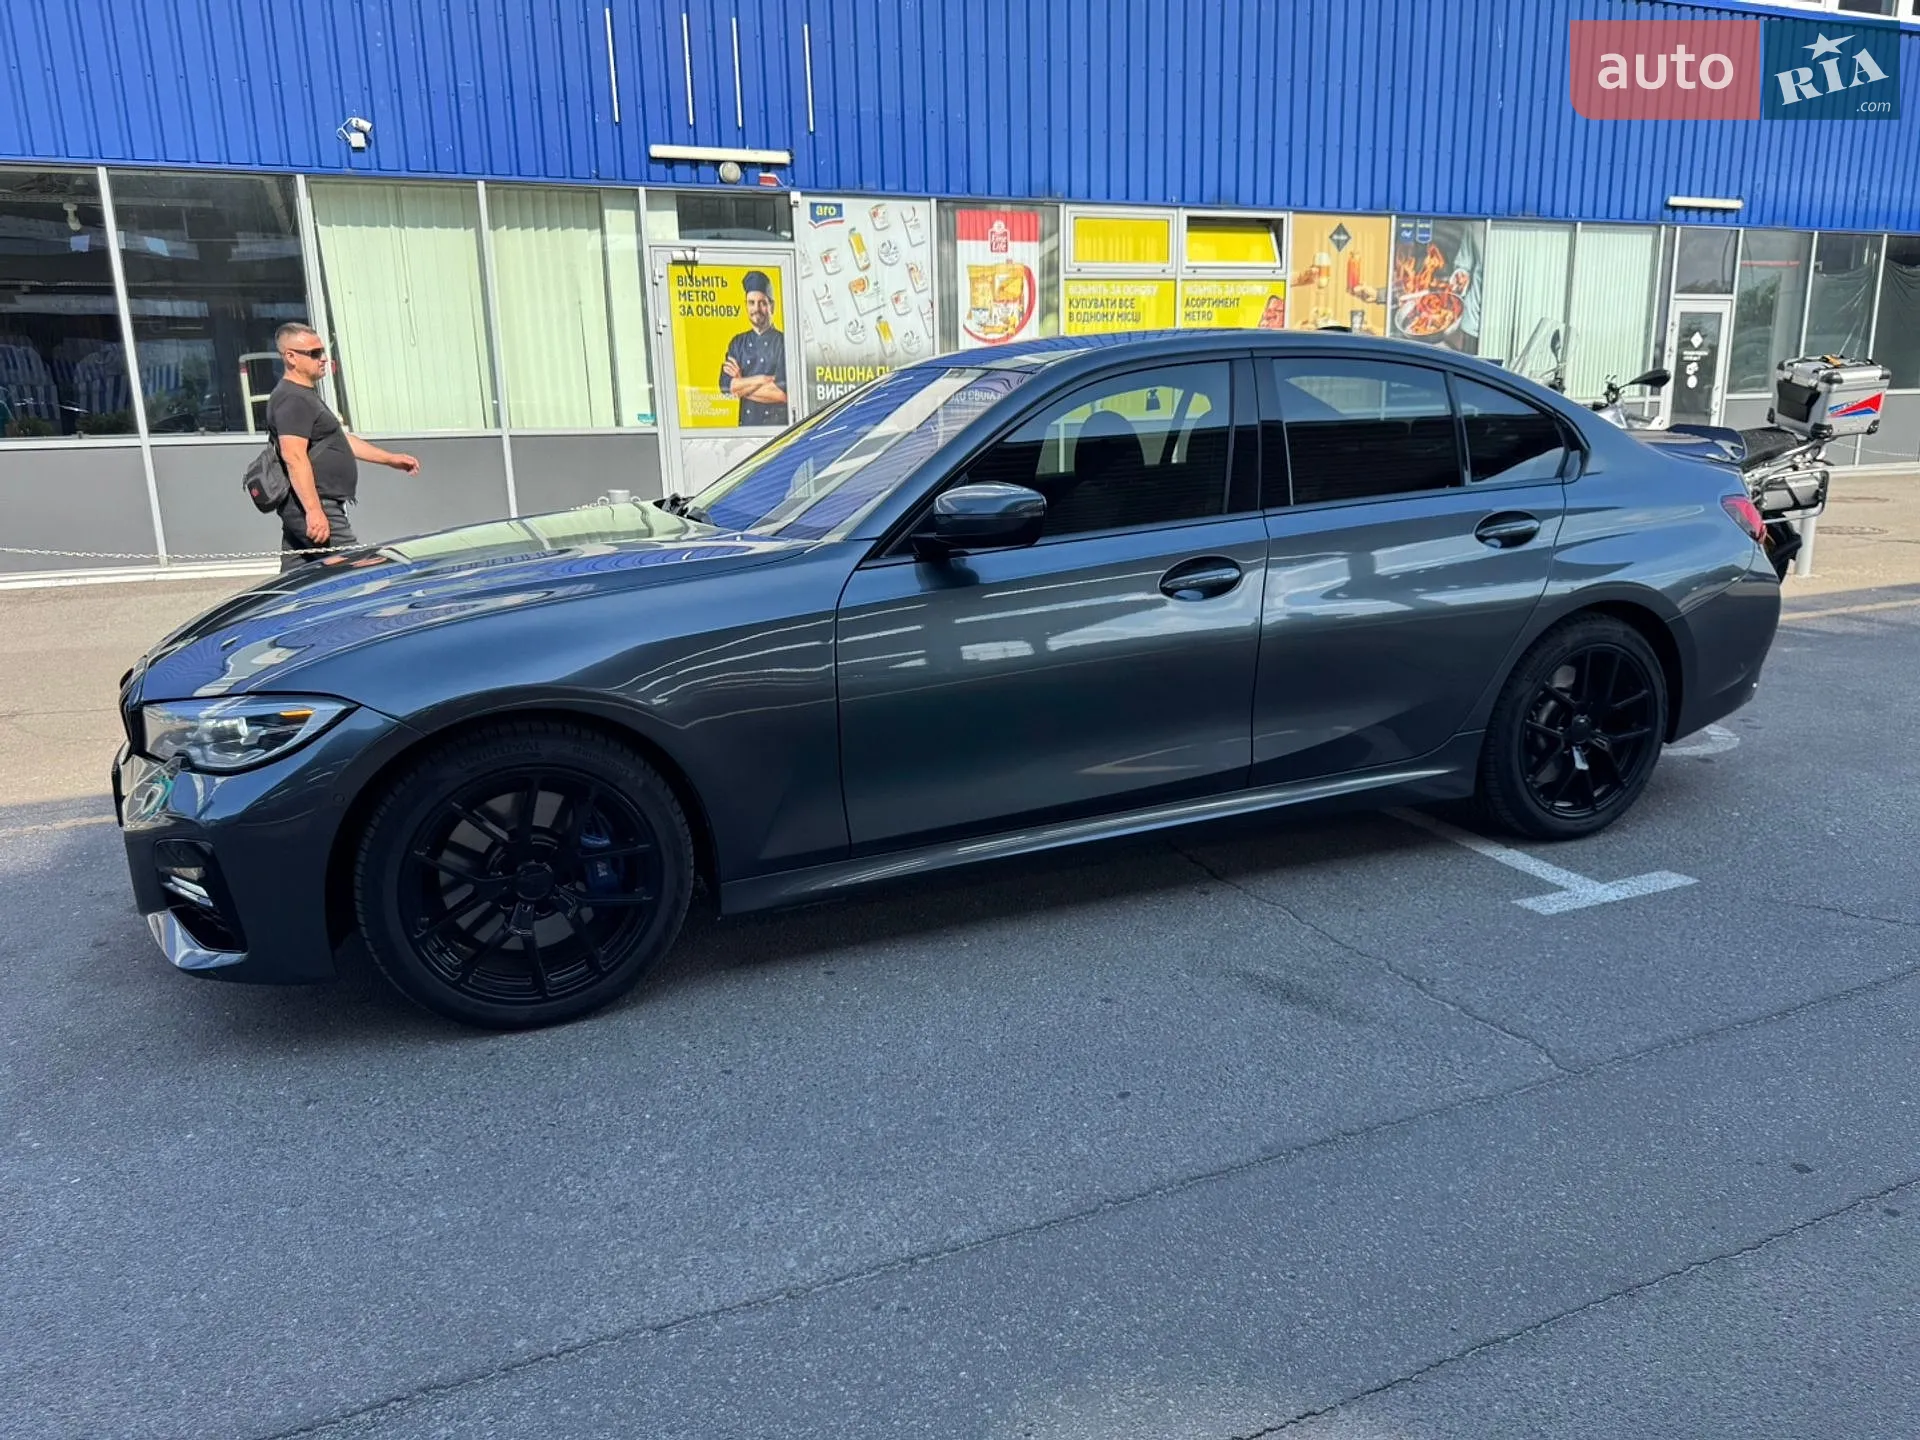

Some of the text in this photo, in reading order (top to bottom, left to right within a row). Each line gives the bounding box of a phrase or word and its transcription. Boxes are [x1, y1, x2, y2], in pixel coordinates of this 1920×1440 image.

[815, 205, 837, 217] aro
[677, 275, 728, 288] ВІЗЬМІТЬ
[678, 290, 716, 302] METRO
[1068, 297, 1136, 309] КУПУВАТИ ВСЕ
[1184, 297, 1241, 309] АСОРТИМЕНТ
[679, 304, 741, 317] ЗА ОСНОВУ
[1184, 310, 1213, 321] METRO
[1068, 311, 1074, 322] В
[1076, 311, 1115, 324] ОДНОМУ
